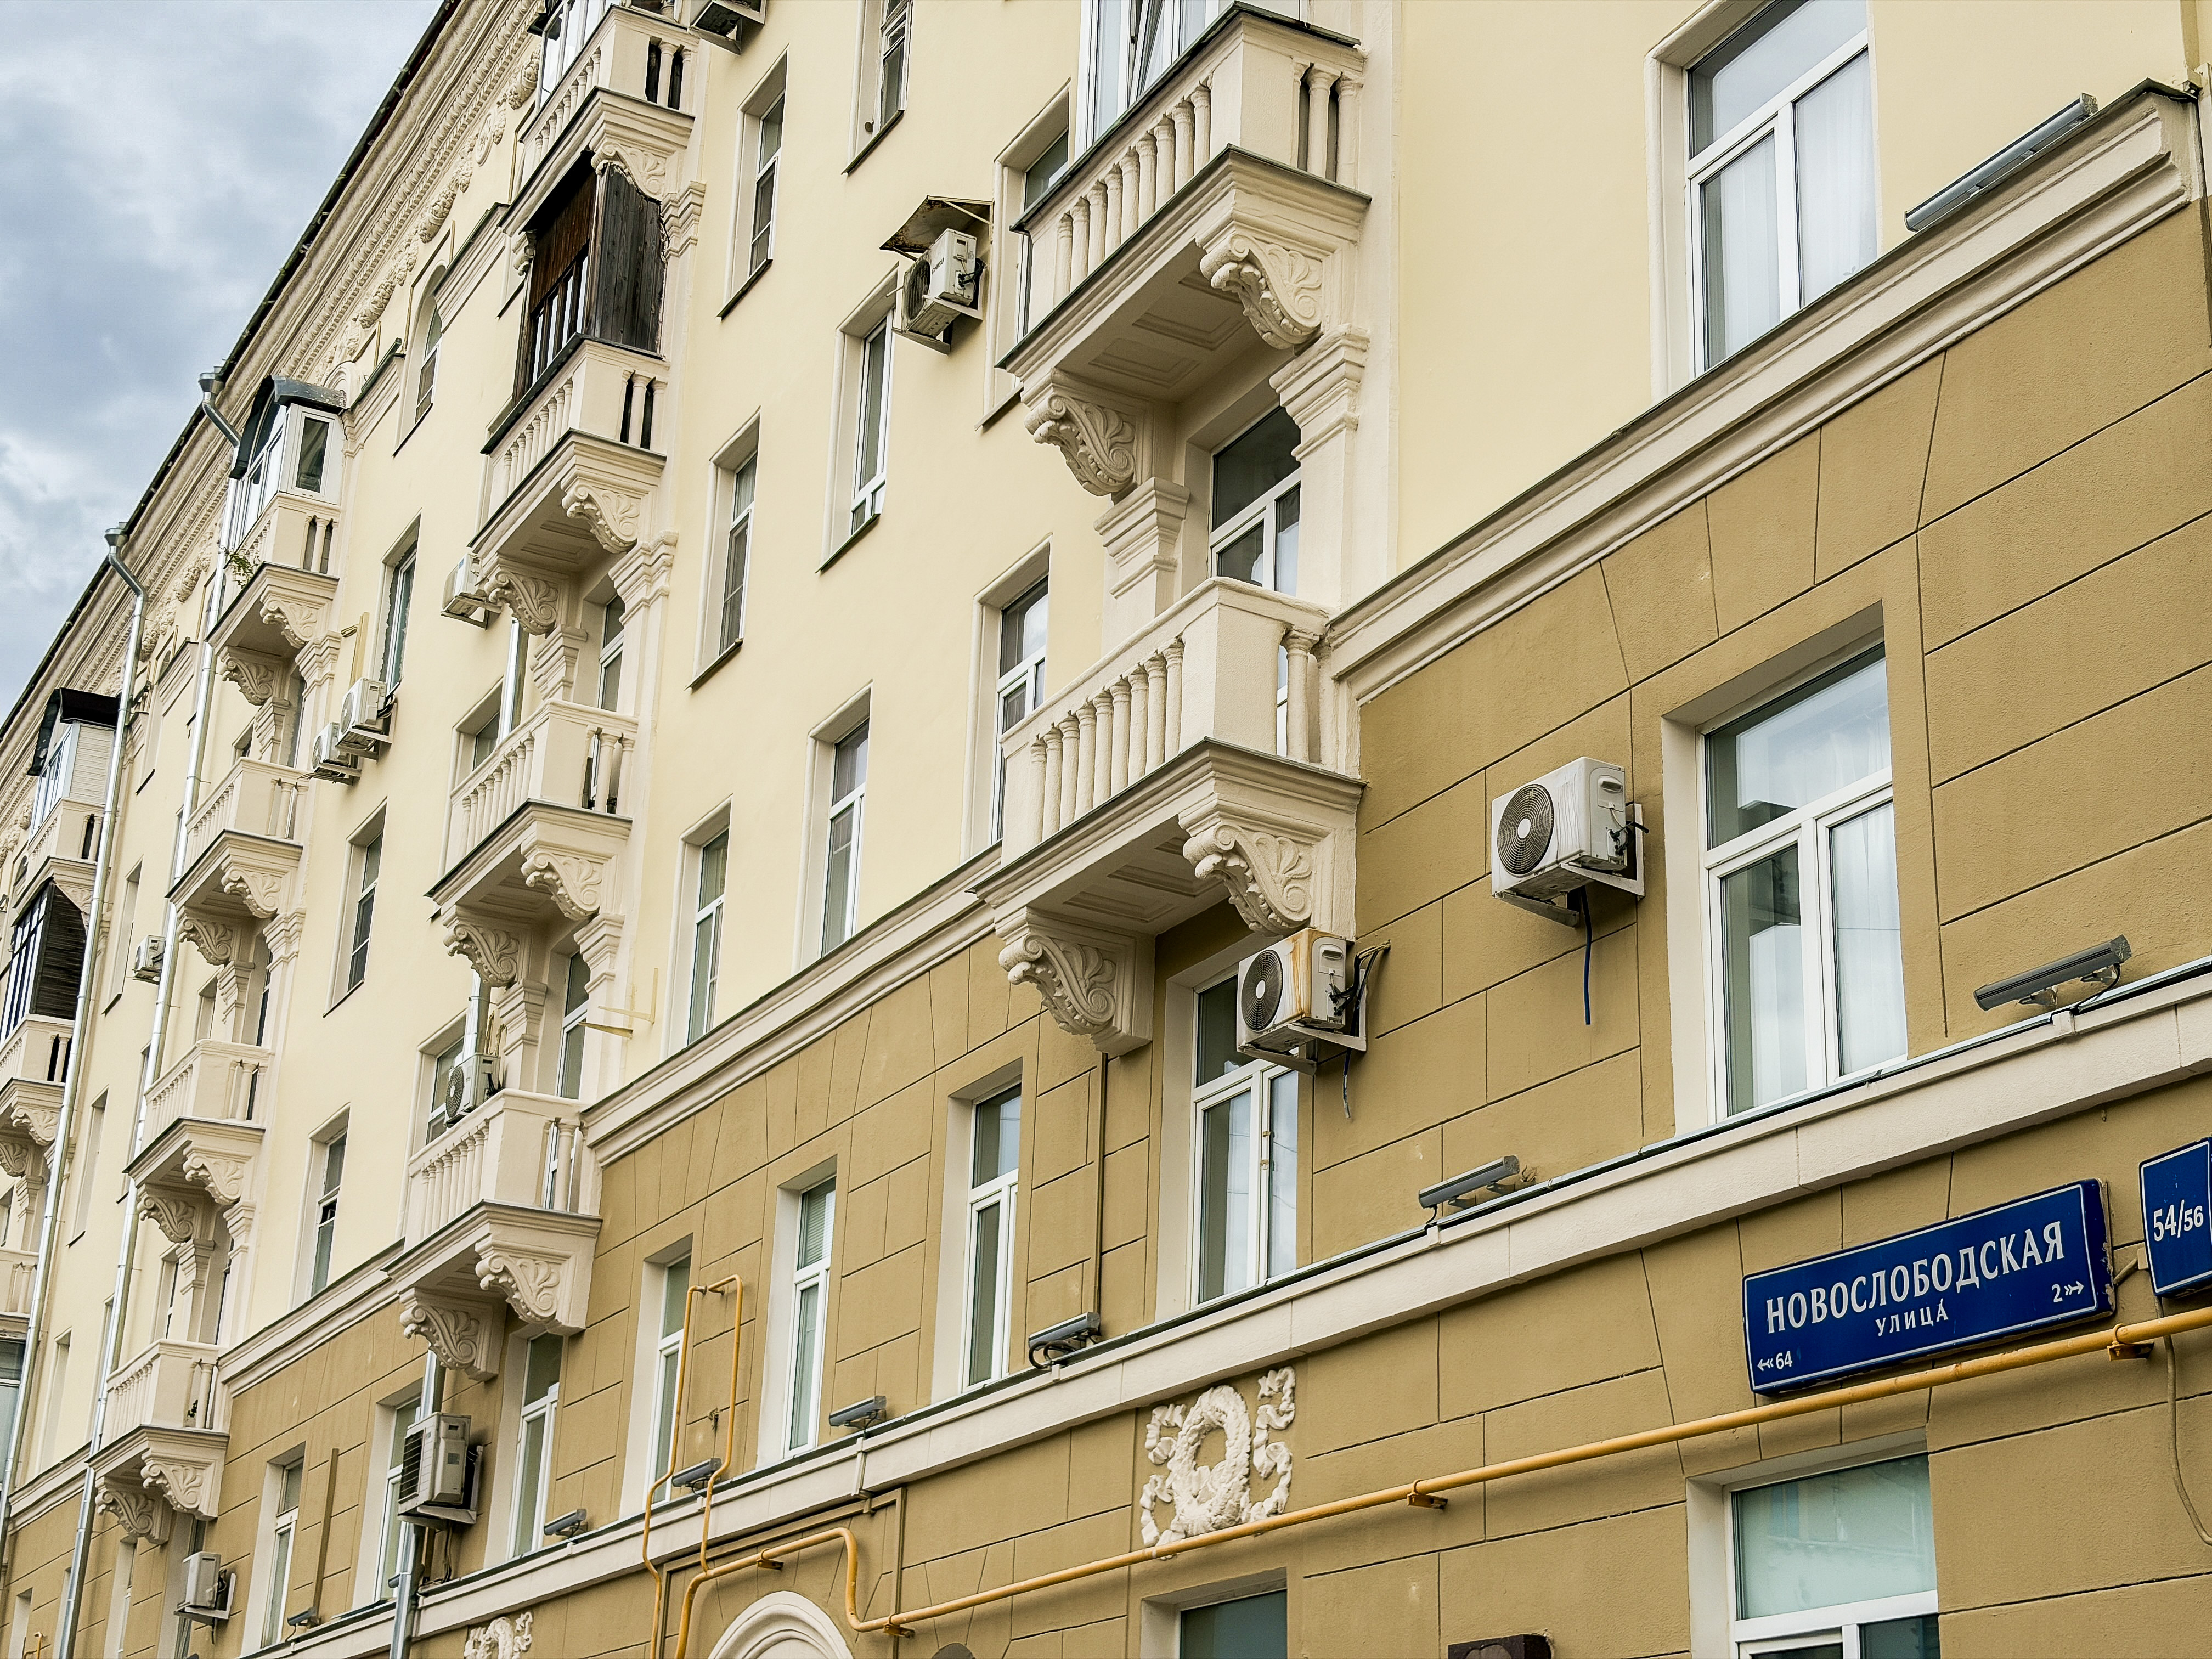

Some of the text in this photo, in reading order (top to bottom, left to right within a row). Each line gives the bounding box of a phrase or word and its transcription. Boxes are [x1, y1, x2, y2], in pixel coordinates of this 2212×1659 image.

[2153, 1199, 2204, 1242] 54/56
[1766, 1221, 2064, 1334] НОВОСЛОБОДСКАЯ
[2052, 1284, 2063, 1303] 2
[1875, 1301, 1949, 1336] УЛИЦА
[1776, 1351, 1793, 1370] 64
